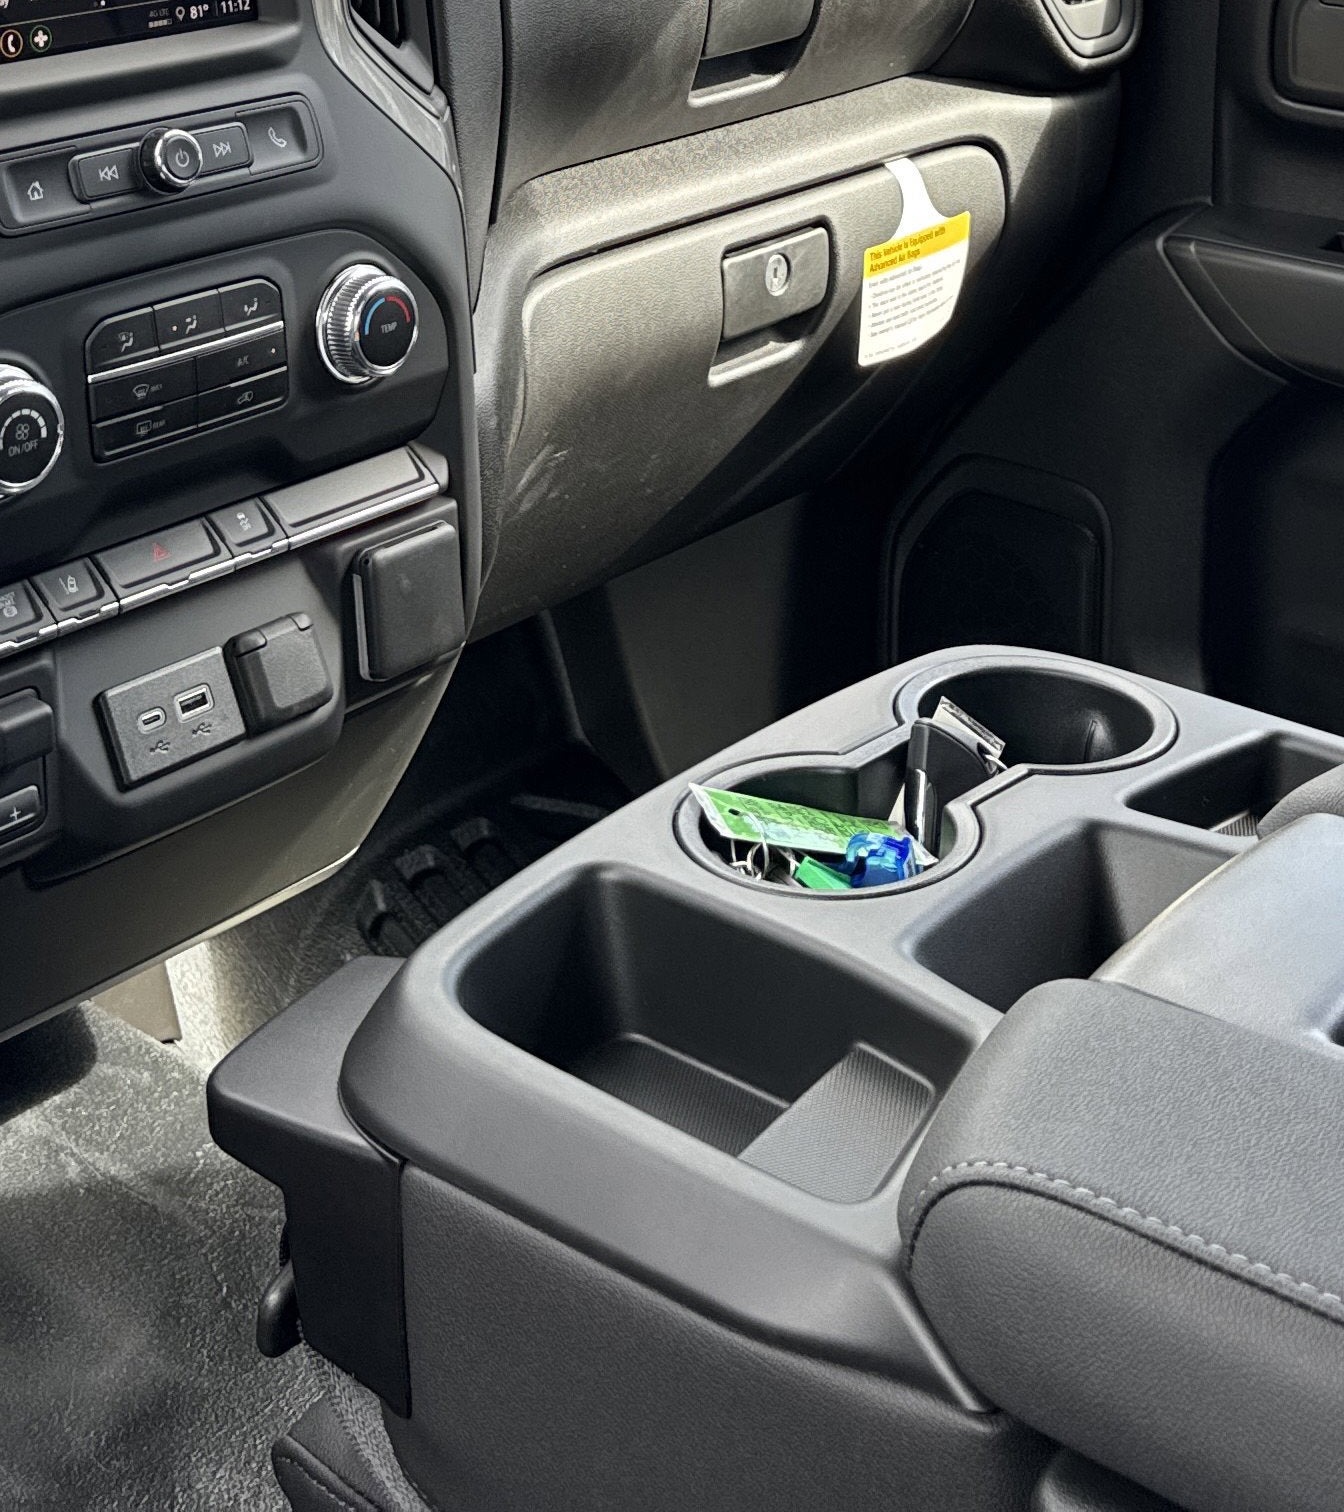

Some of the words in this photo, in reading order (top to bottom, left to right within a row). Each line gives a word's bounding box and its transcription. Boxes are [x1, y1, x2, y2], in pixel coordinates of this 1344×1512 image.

[189, 4, 209, 20] 81°
[869, 251, 882, 261] This
[884, 245, 904, 256] Vehicle
[909, 231, 934, 247] Equipped
[869, 258, 898, 273] Advanced
[907, 248, 921, 261] Bags
[380, 321, 398, 334] TEMP
[8, 439, 39, 457] ON/OFF
